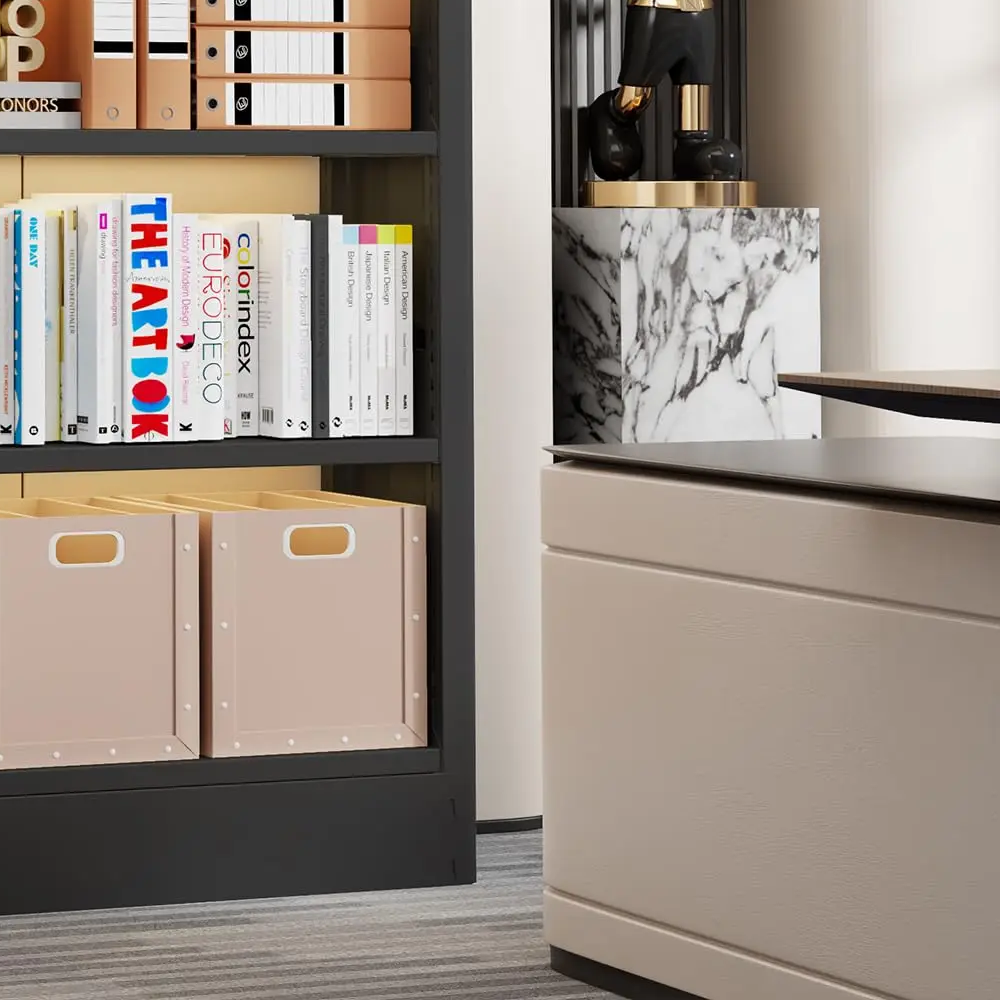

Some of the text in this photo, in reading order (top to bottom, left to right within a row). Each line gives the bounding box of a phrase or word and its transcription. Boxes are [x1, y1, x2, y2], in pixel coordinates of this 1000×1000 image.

[29, 217, 38, 268] ONE DAY
[99, 232, 107, 260] drawing
[130, 197, 168, 269] THE
[180, 226, 190, 256] History
[182, 266, 190, 297] Modern
[346, 278, 355, 308] Design
[364, 250, 373, 322] Japanese Design
[382, 276, 391, 306] Design
[132, 283, 168, 350] ART
[180, 298, 190, 326] Design
[202, 233, 222, 404] EURODECO
[237, 233, 254, 374] colorindex
[400, 291, 408, 320] Design
